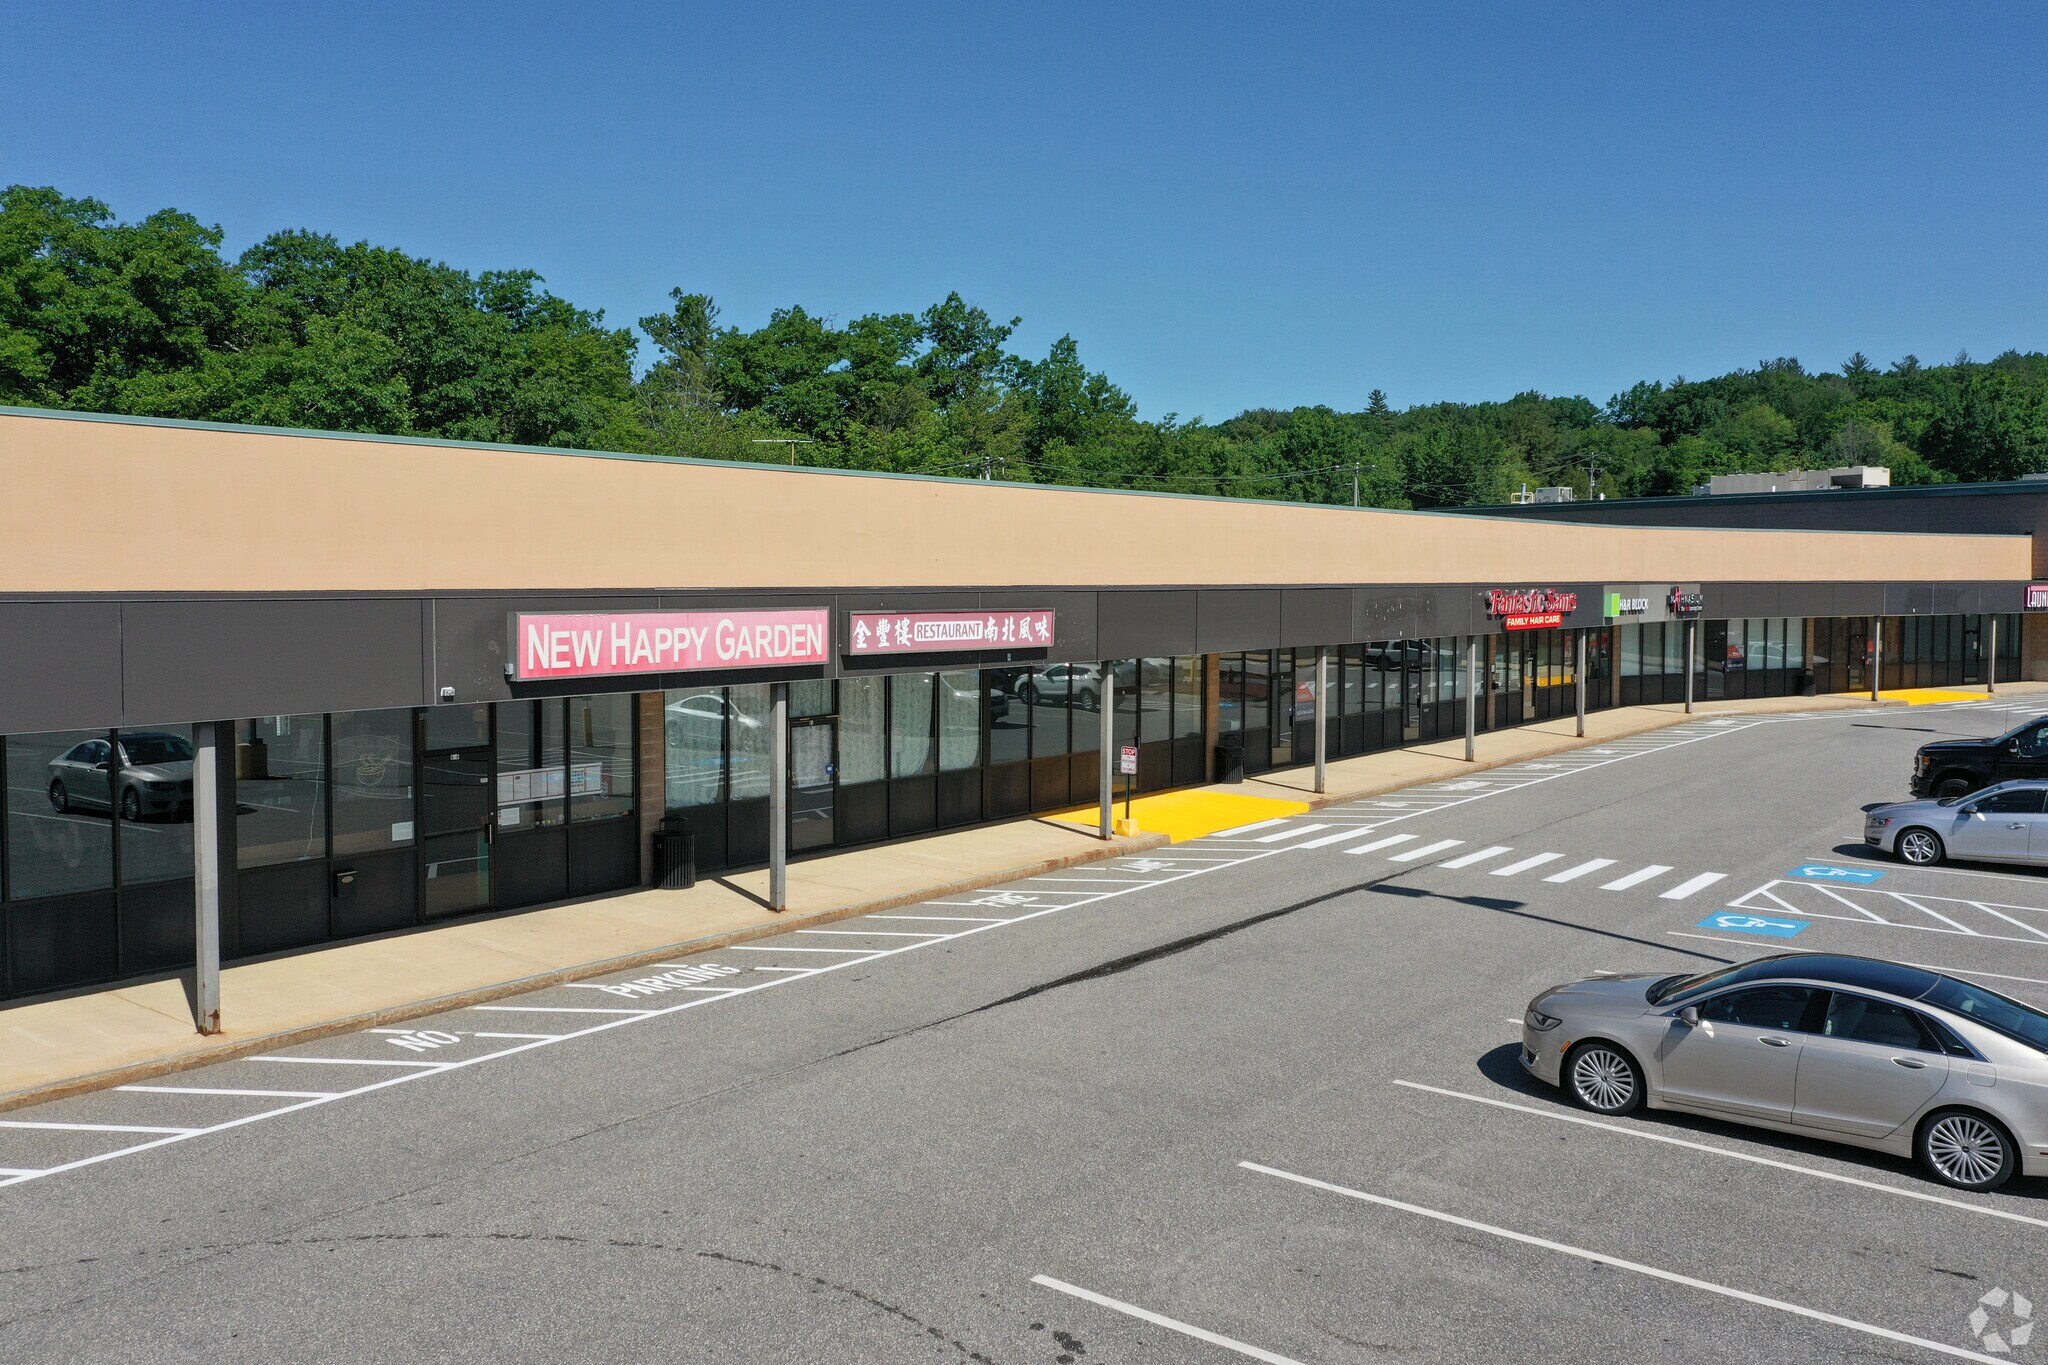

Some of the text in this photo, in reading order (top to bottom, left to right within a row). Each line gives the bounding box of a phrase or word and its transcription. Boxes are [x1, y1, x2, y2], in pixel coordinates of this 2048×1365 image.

[1490, 587, 1577, 614] Fantastic Sams
[1619, 598, 1649, 611] H&R BLOCK
[2027, 586, 2048, 608] LAUN
[916, 622, 982, 639] RESTAURANT
[1507, 615, 1560, 627] FAMILY HAIR CARE
[527, 618, 822, 670] NEW HAPPY GARDEN
[385, 1030, 461, 1052] NO
[600, 963, 741, 998] PARKING
